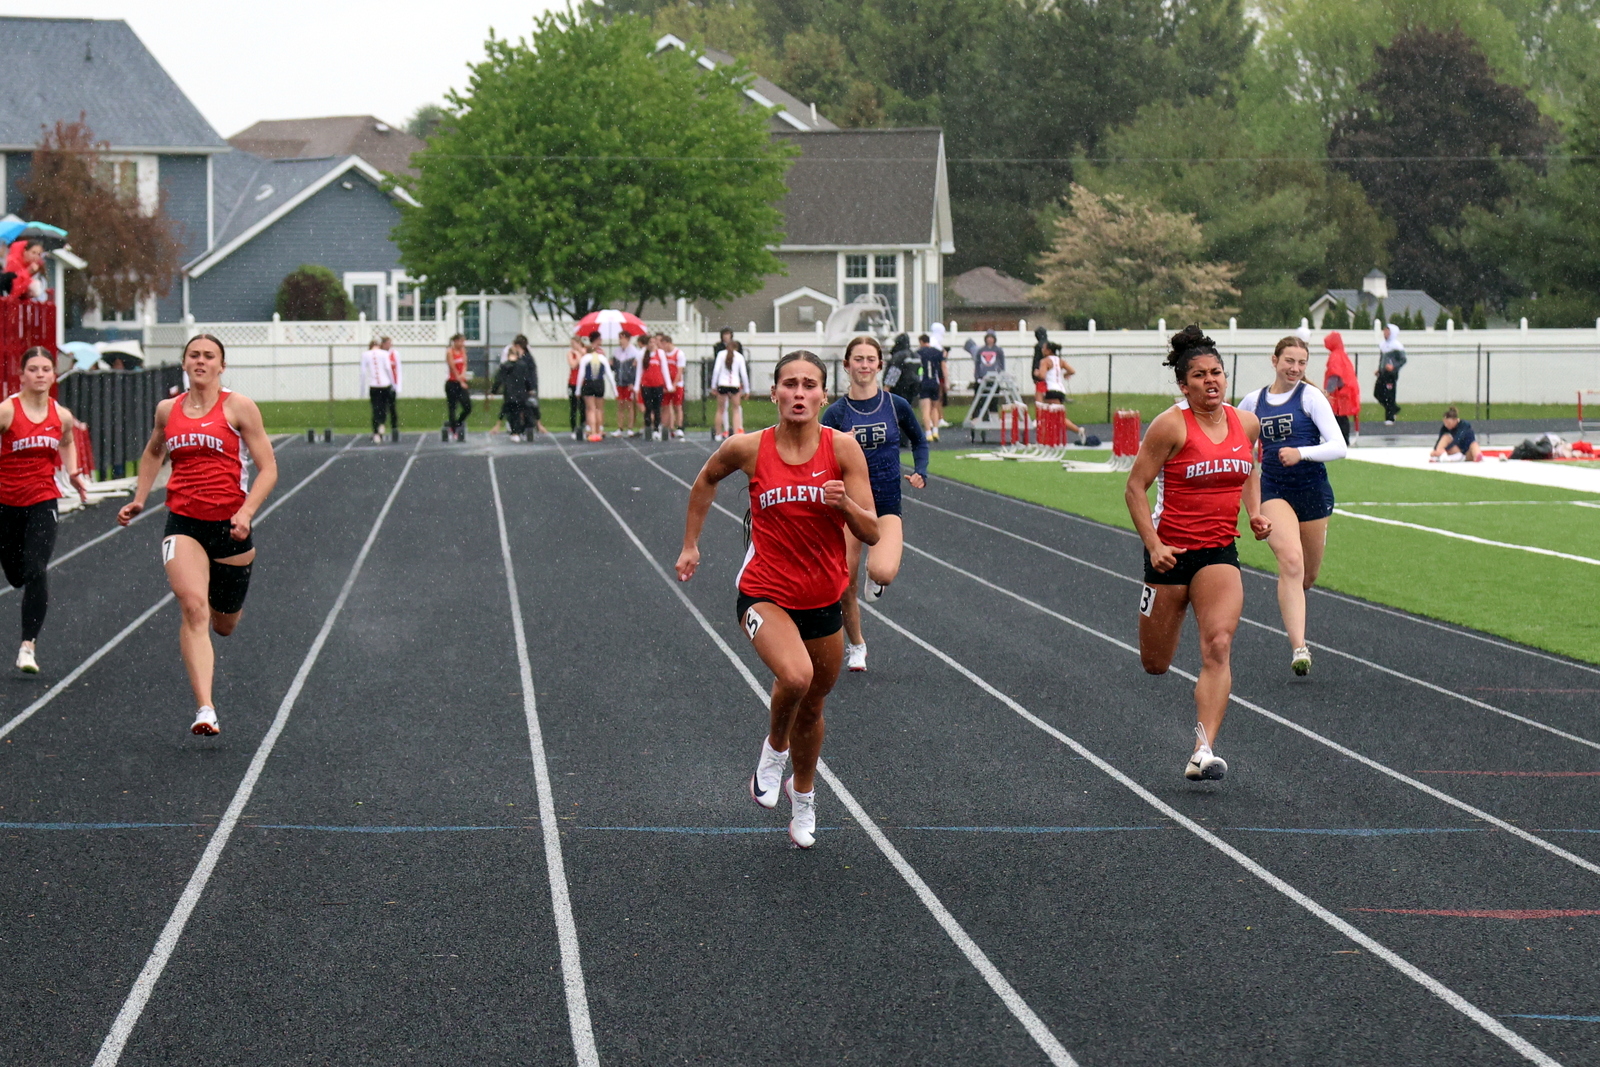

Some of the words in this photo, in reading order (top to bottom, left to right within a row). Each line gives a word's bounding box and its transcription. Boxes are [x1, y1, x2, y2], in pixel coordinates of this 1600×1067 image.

[12, 435, 60, 452] BELLEVU
[166, 433, 224, 453] ELLEVUE
[164, 539, 172, 561] 7
[1140, 586, 1152, 612] 3
[747, 612, 758, 636] 5
